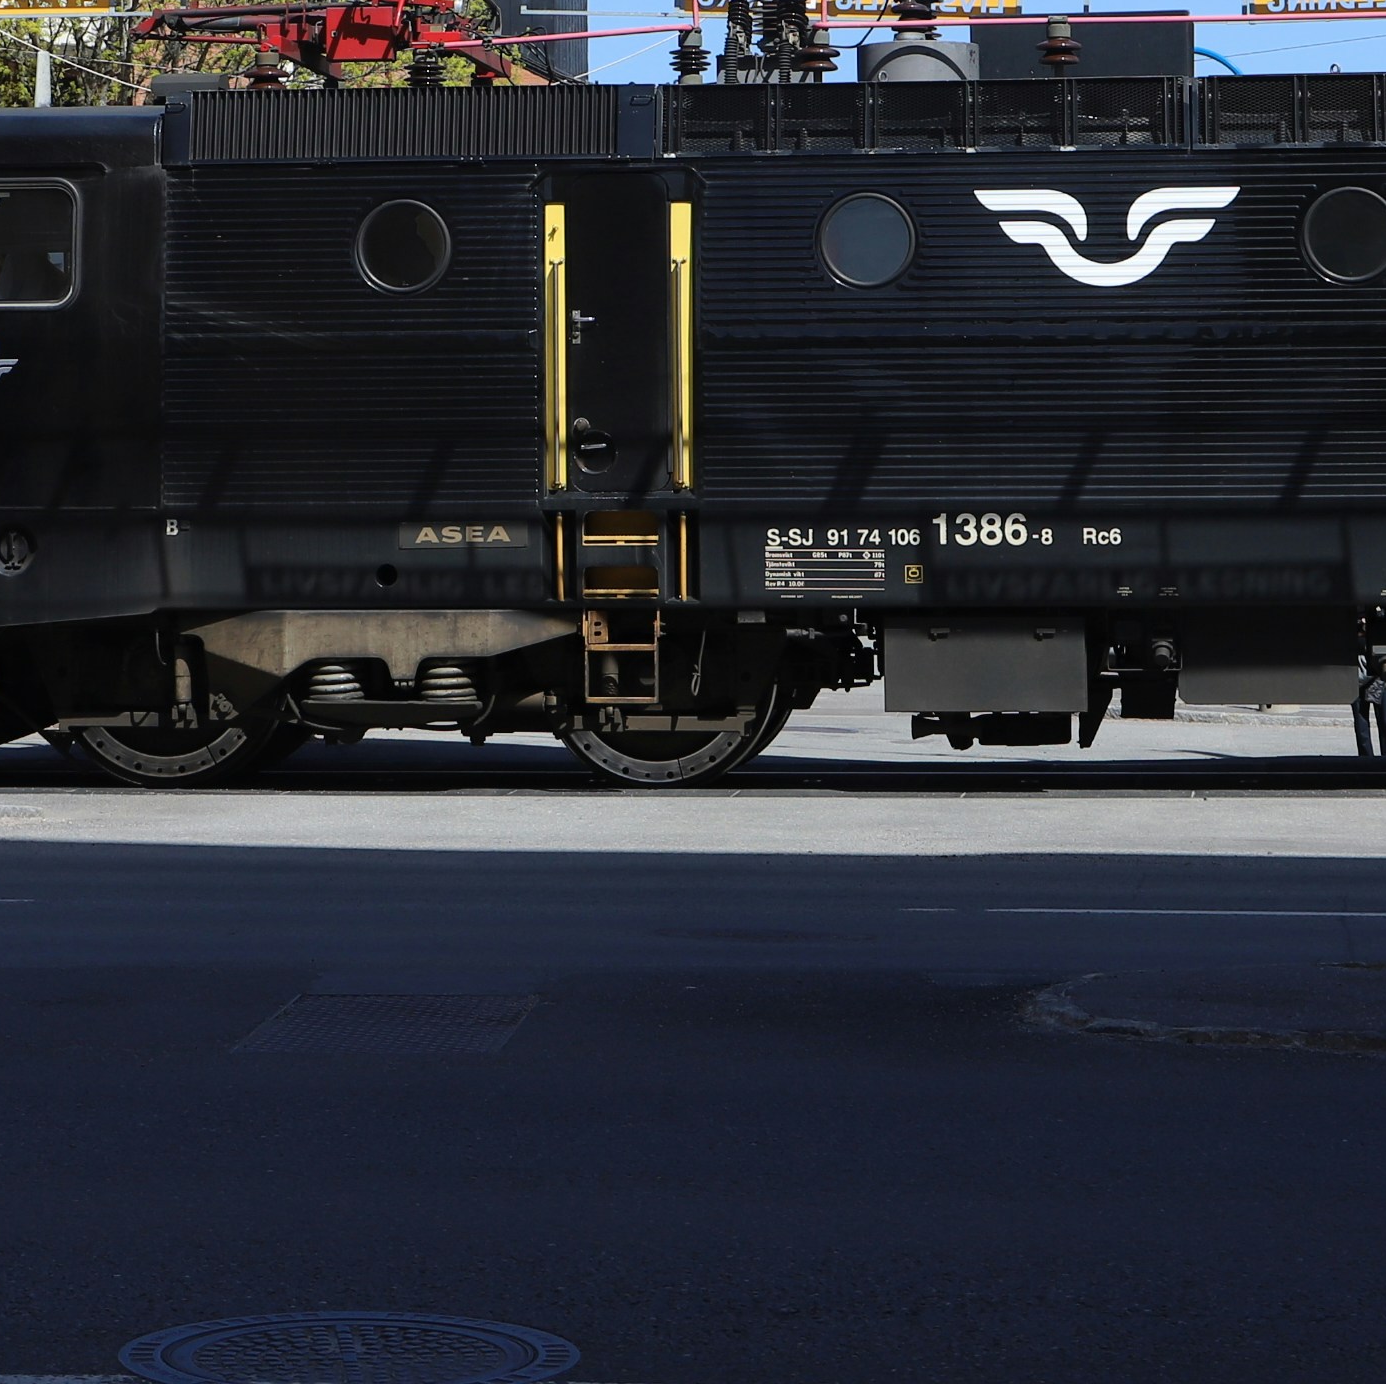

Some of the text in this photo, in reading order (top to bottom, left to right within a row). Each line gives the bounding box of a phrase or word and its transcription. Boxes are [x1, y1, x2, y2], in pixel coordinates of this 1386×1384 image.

[166, 519, 178, 536] B
[415, 525, 511, 544] ASEA
[766, 528, 814, 546] S-SJ
[826, 528, 849, 546] 91
[857, 528, 881, 546] 74
[888, 528, 921, 546] 106
[1082, 527, 1122, 546] Rc6
